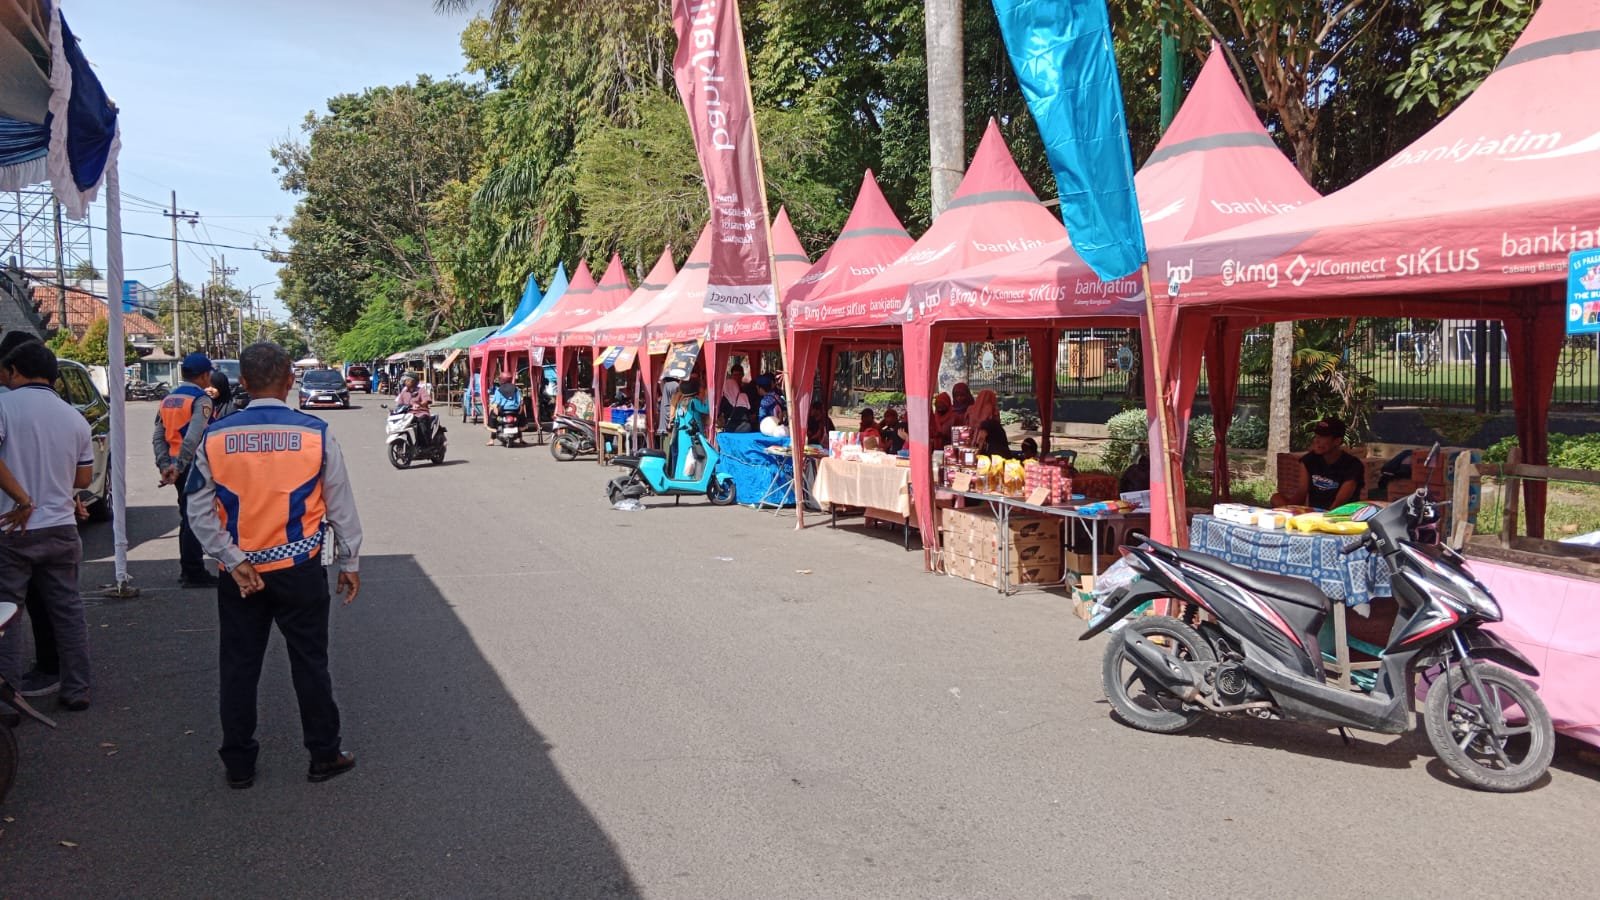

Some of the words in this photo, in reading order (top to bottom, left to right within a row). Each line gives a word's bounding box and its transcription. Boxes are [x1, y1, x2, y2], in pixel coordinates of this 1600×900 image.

[1389, 129, 1562, 169] bankjatim
[1210, 197, 1303, 216] bankja
[972, 238, 1047, 253] bankja
[1313, 256, 1387, 277] JConnect
[1395, 246, 1480, 277] SIKLUS
[1028, 283, 1066, 302] SIKLUS
[1075, 278, 1137, 298] bankjatim
[870, 297, 902, 312] bankjatim
[225, 431, 302, 455] DISHUB
